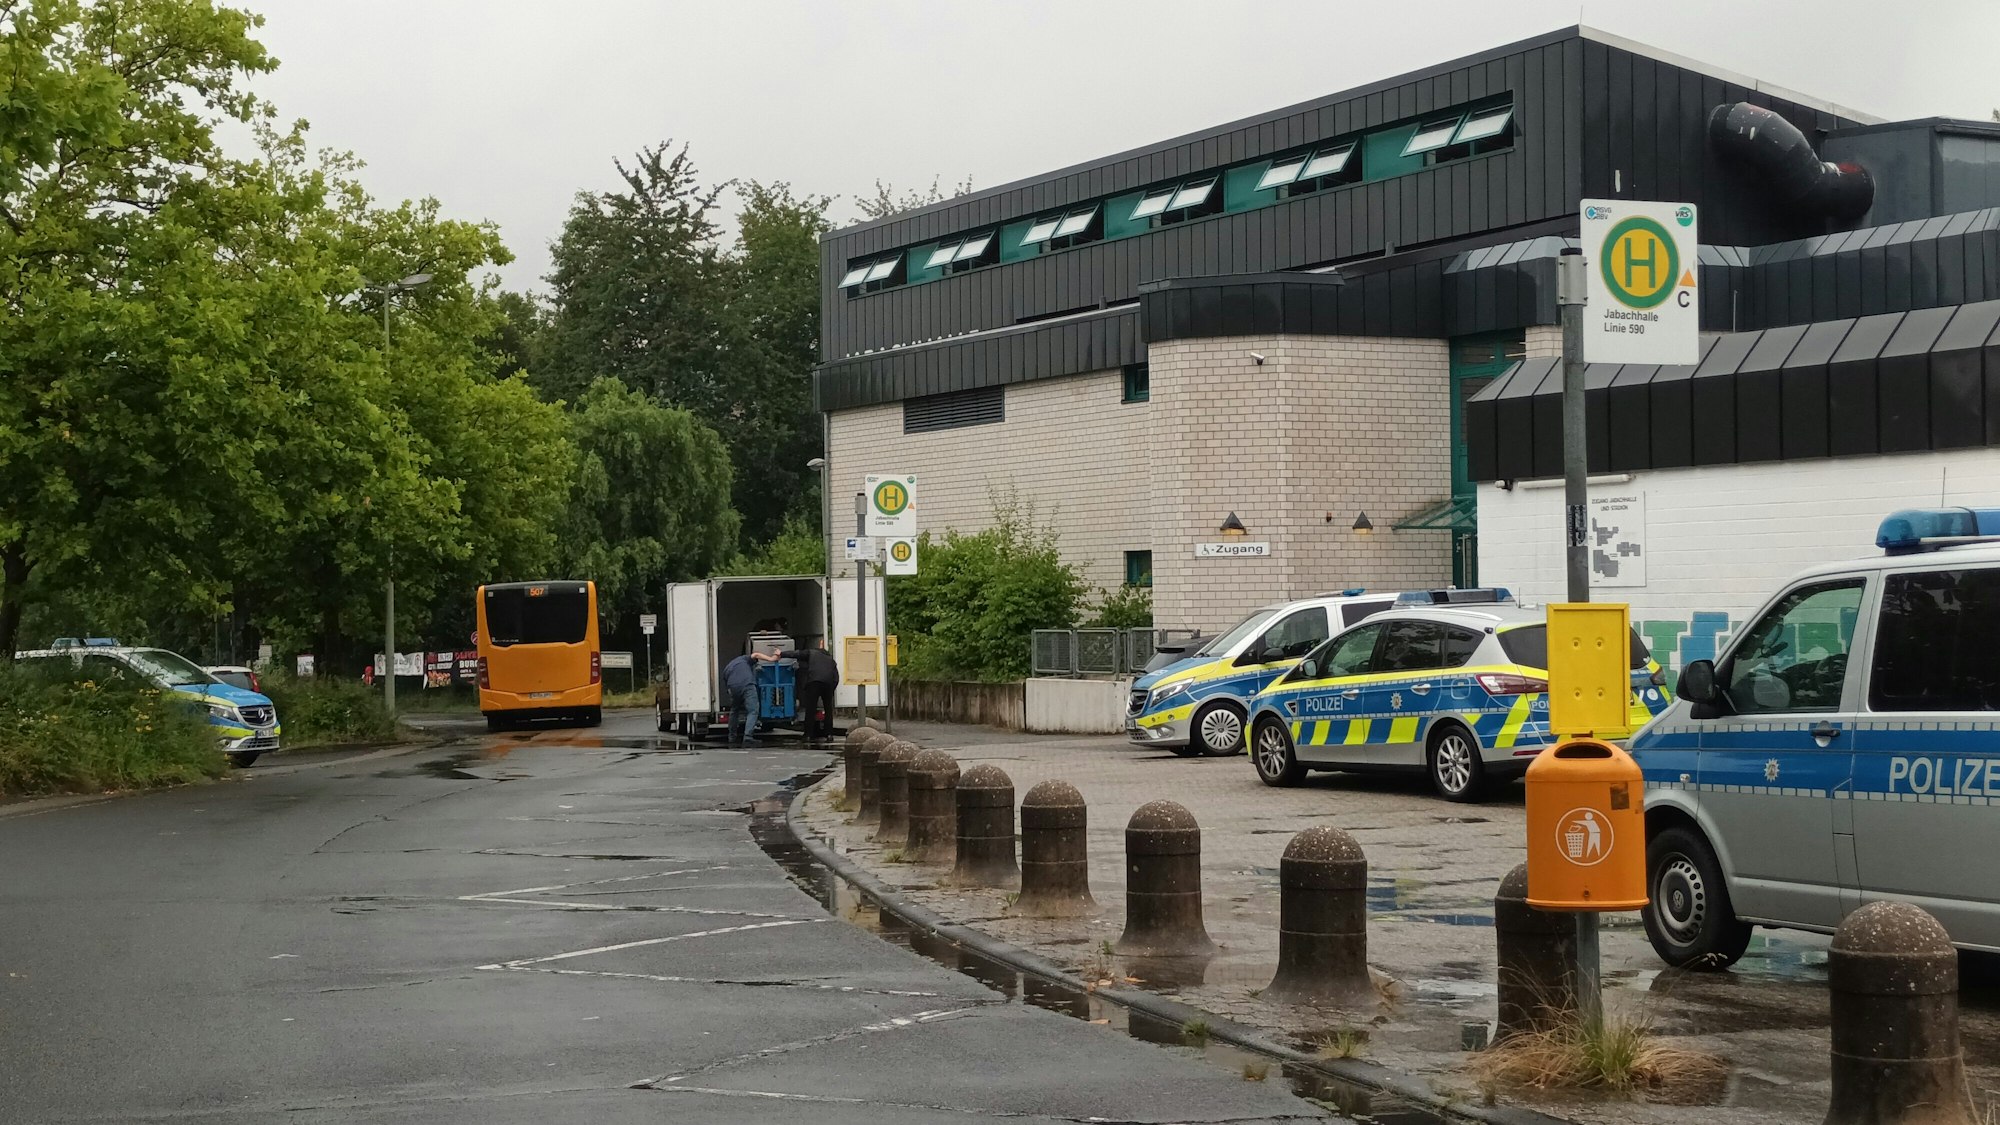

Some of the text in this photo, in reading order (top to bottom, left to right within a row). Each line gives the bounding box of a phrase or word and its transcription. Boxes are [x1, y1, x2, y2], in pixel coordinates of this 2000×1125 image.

[1675, 210, 1689, 218] VRS
[1625, 237, 1656, 288] H
[1677, 290, 1691, 308] C
[1603, 308, 1659, 322] Jabachhalle
[1603, 322, 1645, 334] Linie 590
[884, 488, 898, 508] H
[529, 587, 545, 597] 507
[1305, 696, 1344, 712] POLIZEI
